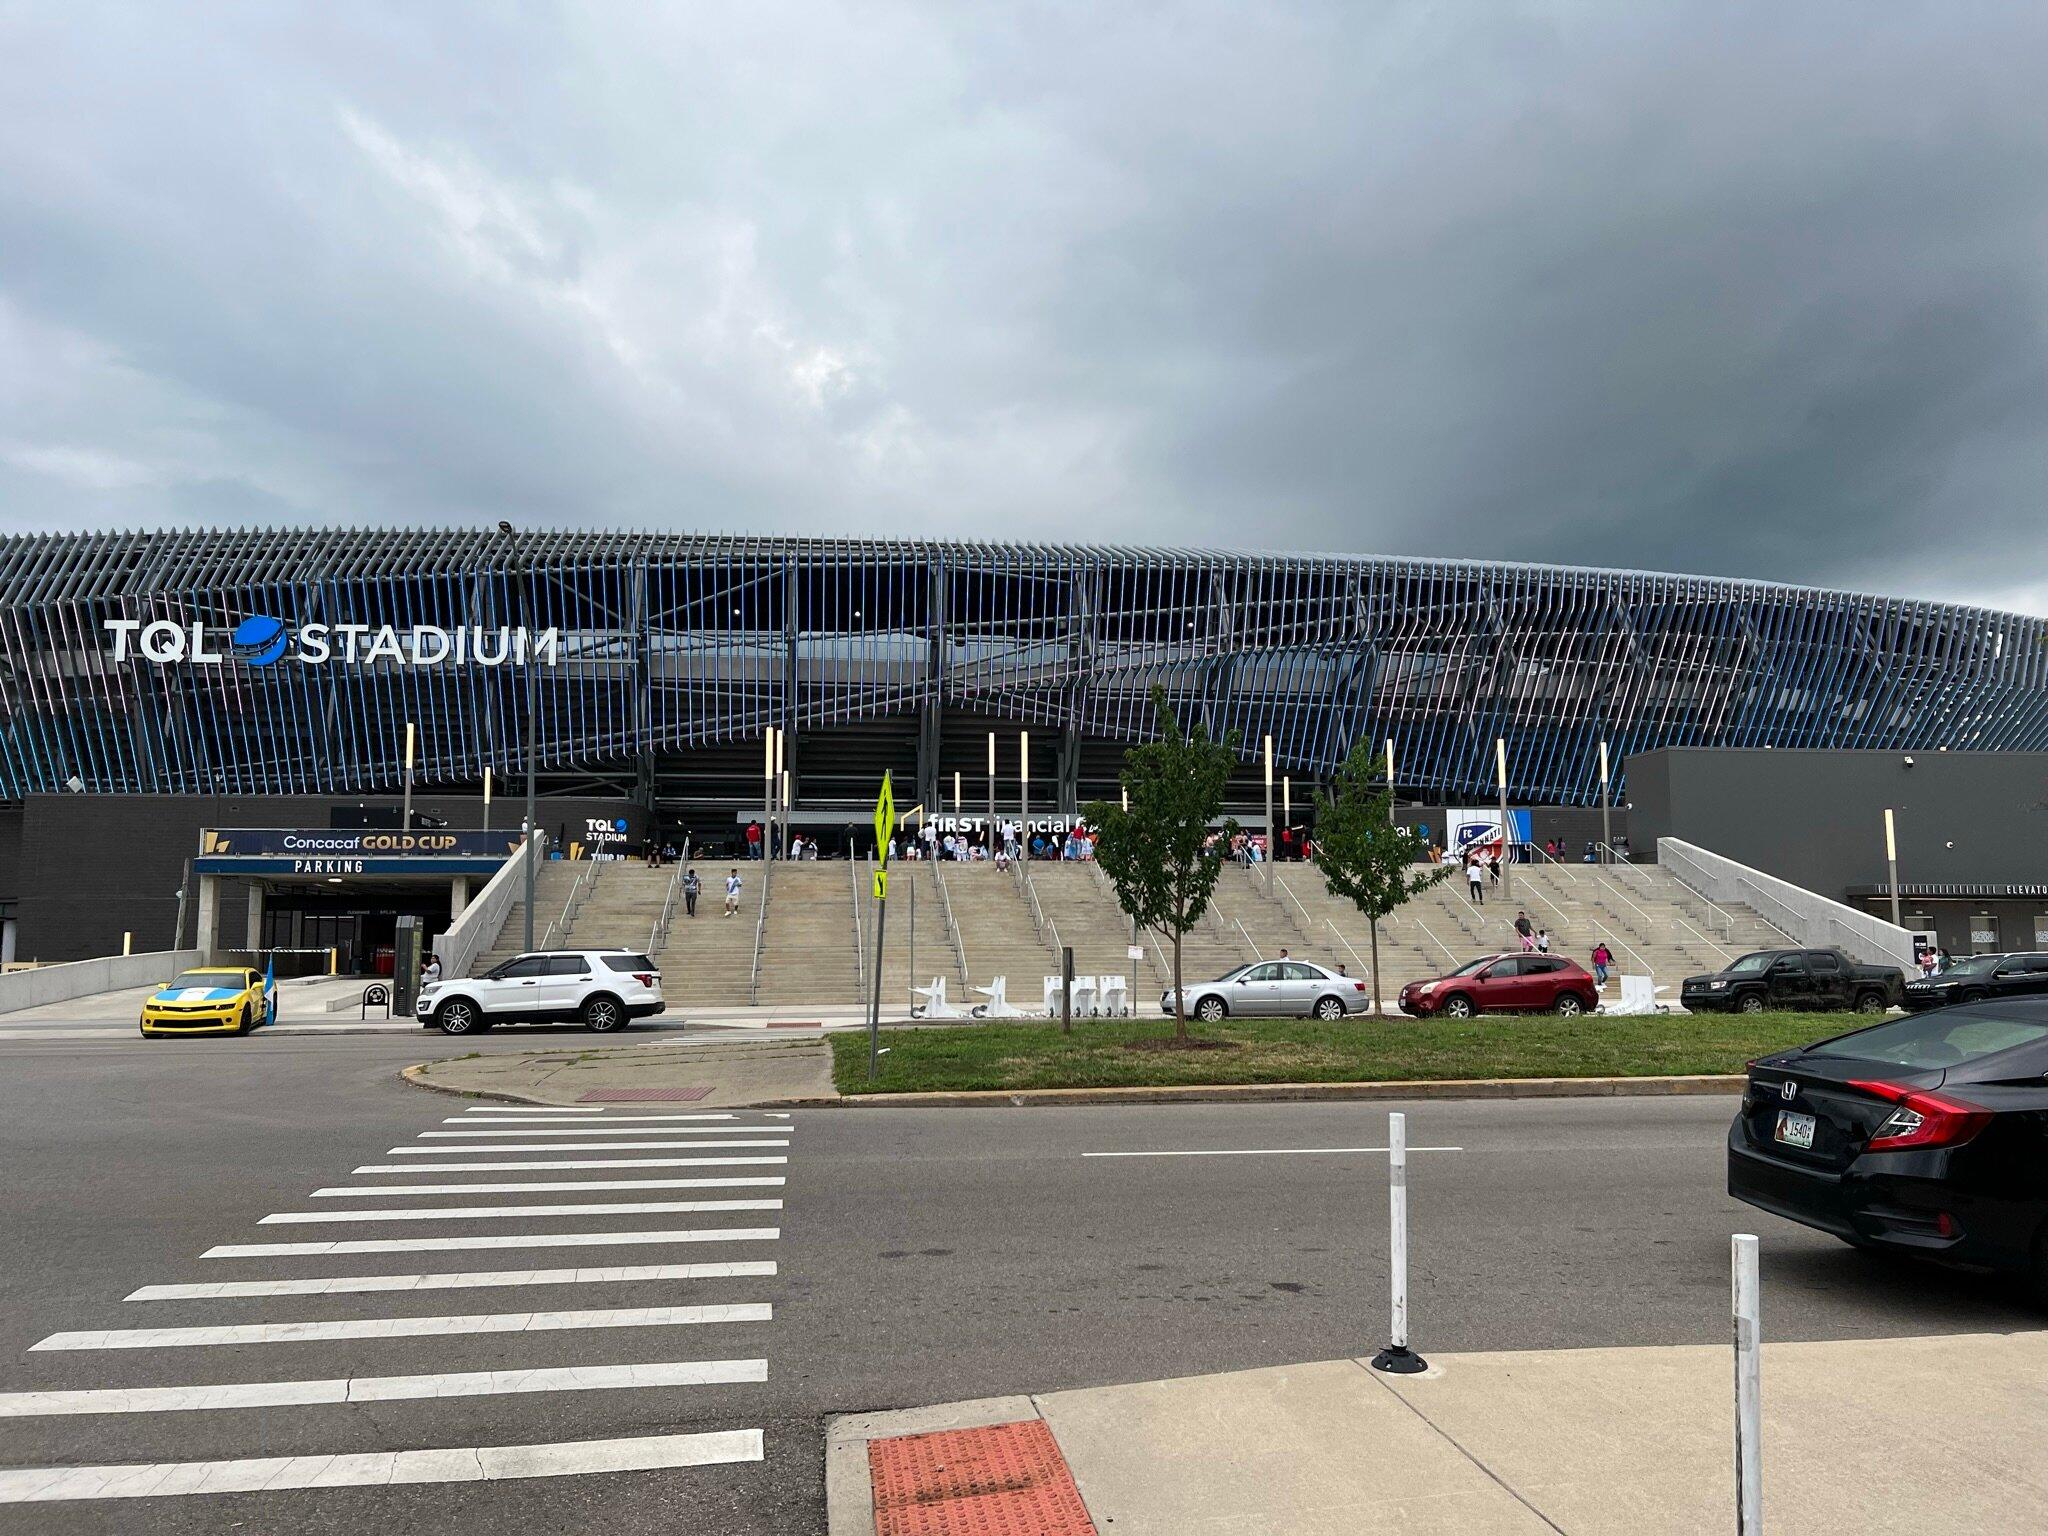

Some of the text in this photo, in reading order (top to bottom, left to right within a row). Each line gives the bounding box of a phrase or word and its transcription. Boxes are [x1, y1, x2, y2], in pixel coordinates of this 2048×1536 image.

[103, 619, 558, 666] TQL STADIUM
[586, 819, 616, 832] TQL
[586, 832, 627, 842] STADIUM
[1394, 826, 1412, 838] QL
[1463, 829, 1473, 838] FC
[283, 835, 457, 850] Concacaf GOLD CUP
[294, 860, 363, 873] PARKING
[2006, 884, 2048, 894] ELEVATO
